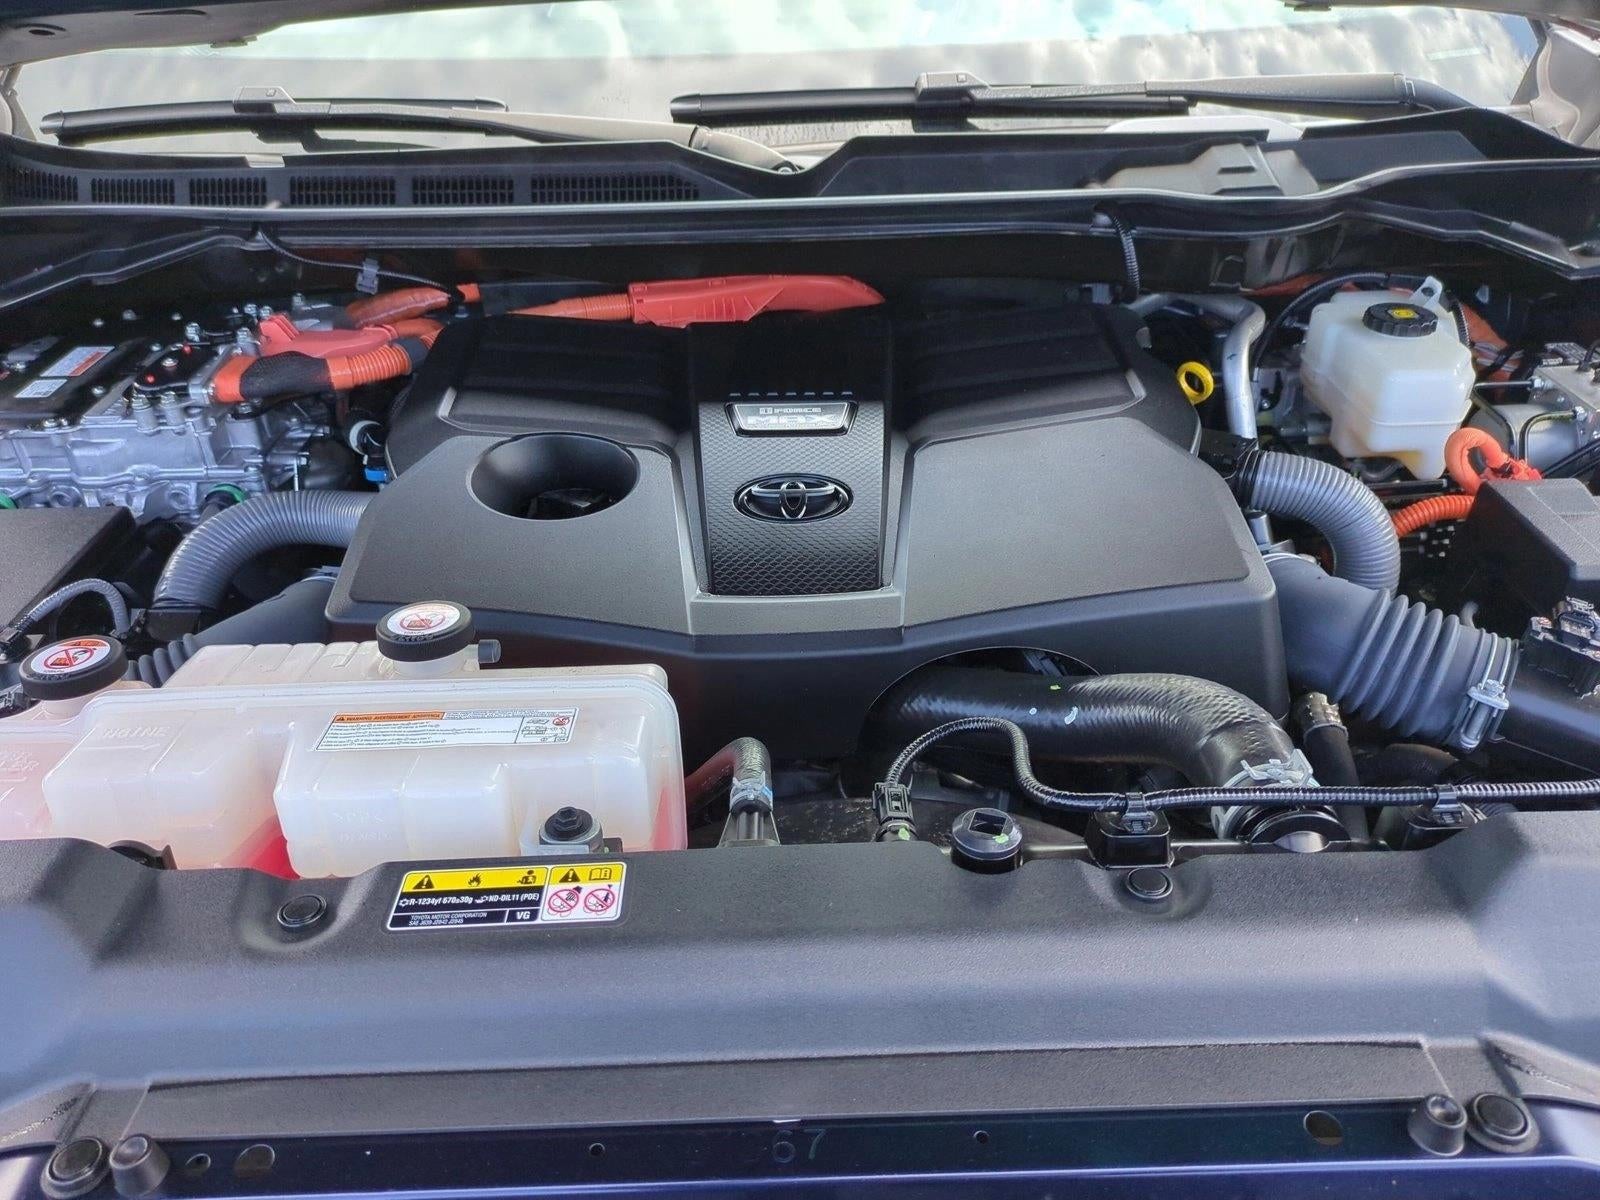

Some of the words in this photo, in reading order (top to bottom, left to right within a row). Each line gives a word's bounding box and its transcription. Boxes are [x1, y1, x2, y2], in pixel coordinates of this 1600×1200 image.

[747, 414, 837, 425] MAX
[409, 897, 442, 906] R-1234yf
[488, 893, 519, 902] ND-OIL11
[520, 892, 540, 902] (POE)
[516, 911, 531, 920] VG
